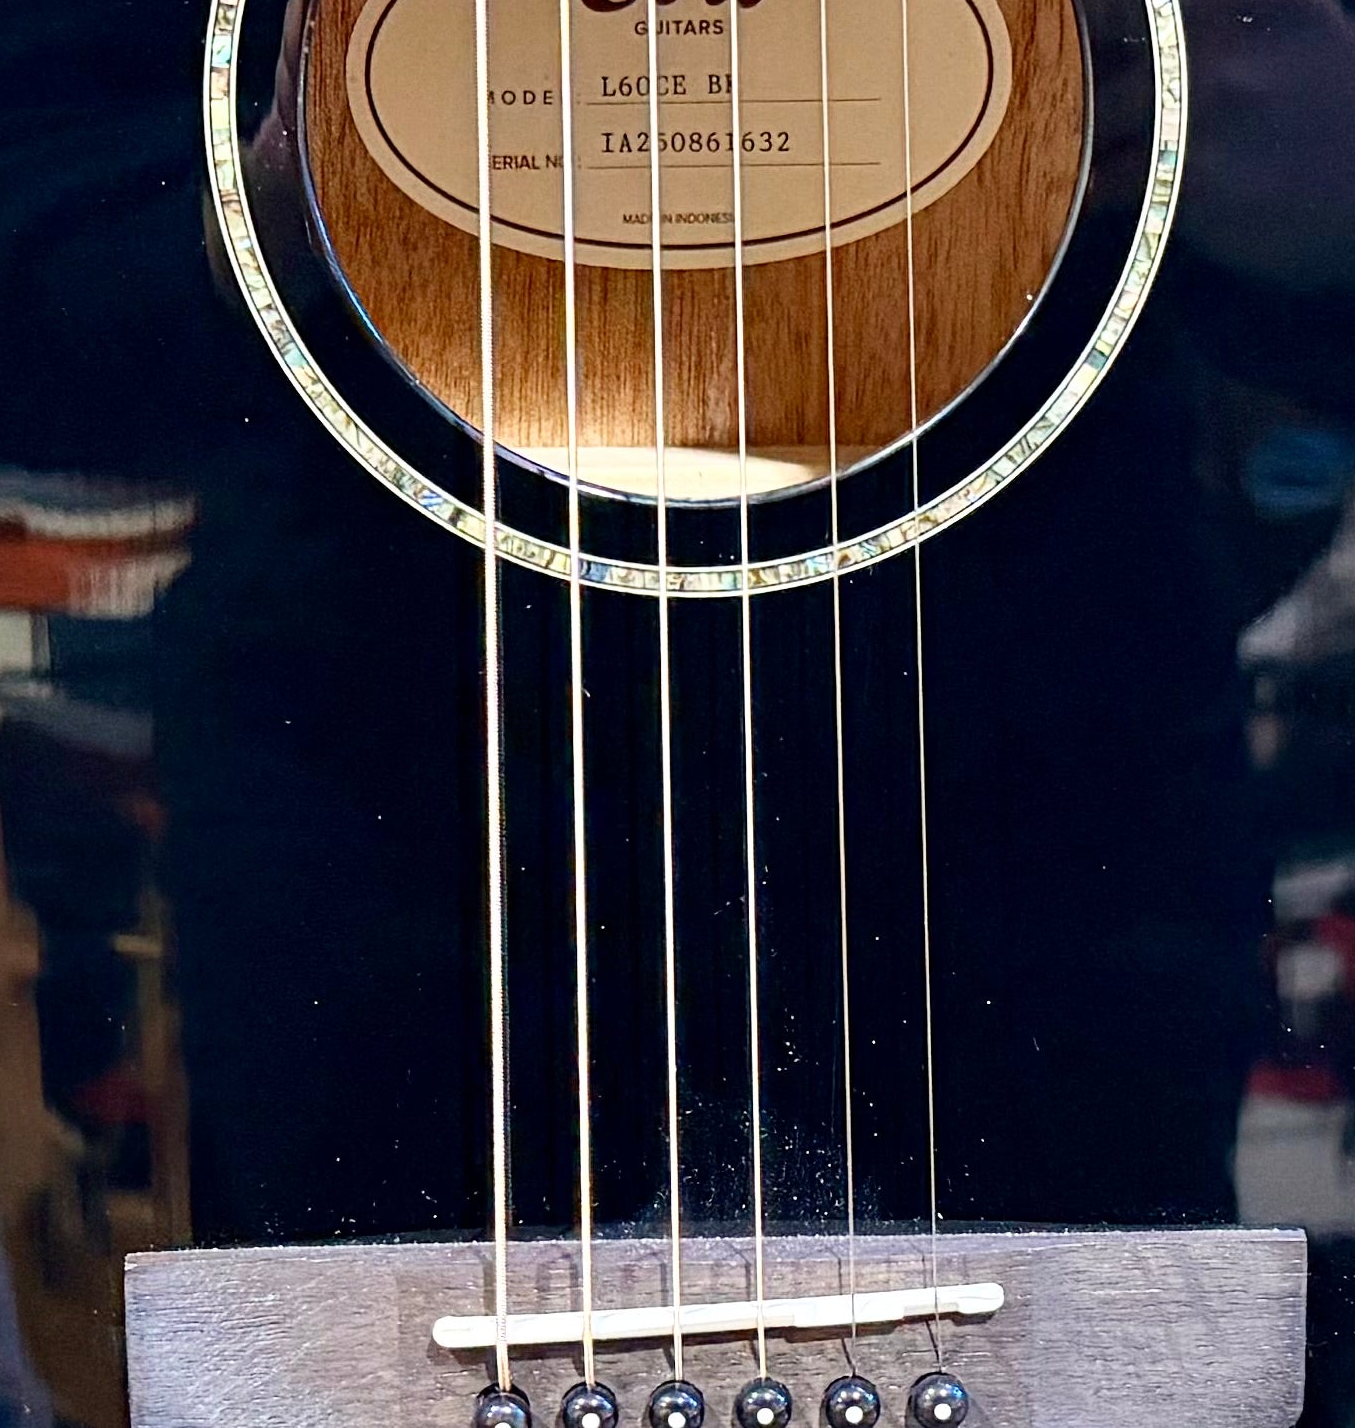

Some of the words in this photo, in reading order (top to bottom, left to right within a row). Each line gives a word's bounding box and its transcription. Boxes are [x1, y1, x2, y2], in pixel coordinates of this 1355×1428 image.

[634, 19, 725, 36] GUITARS
[489, 154, 541, 171] ERIAL
[622, 213, 653, 225] MAD
